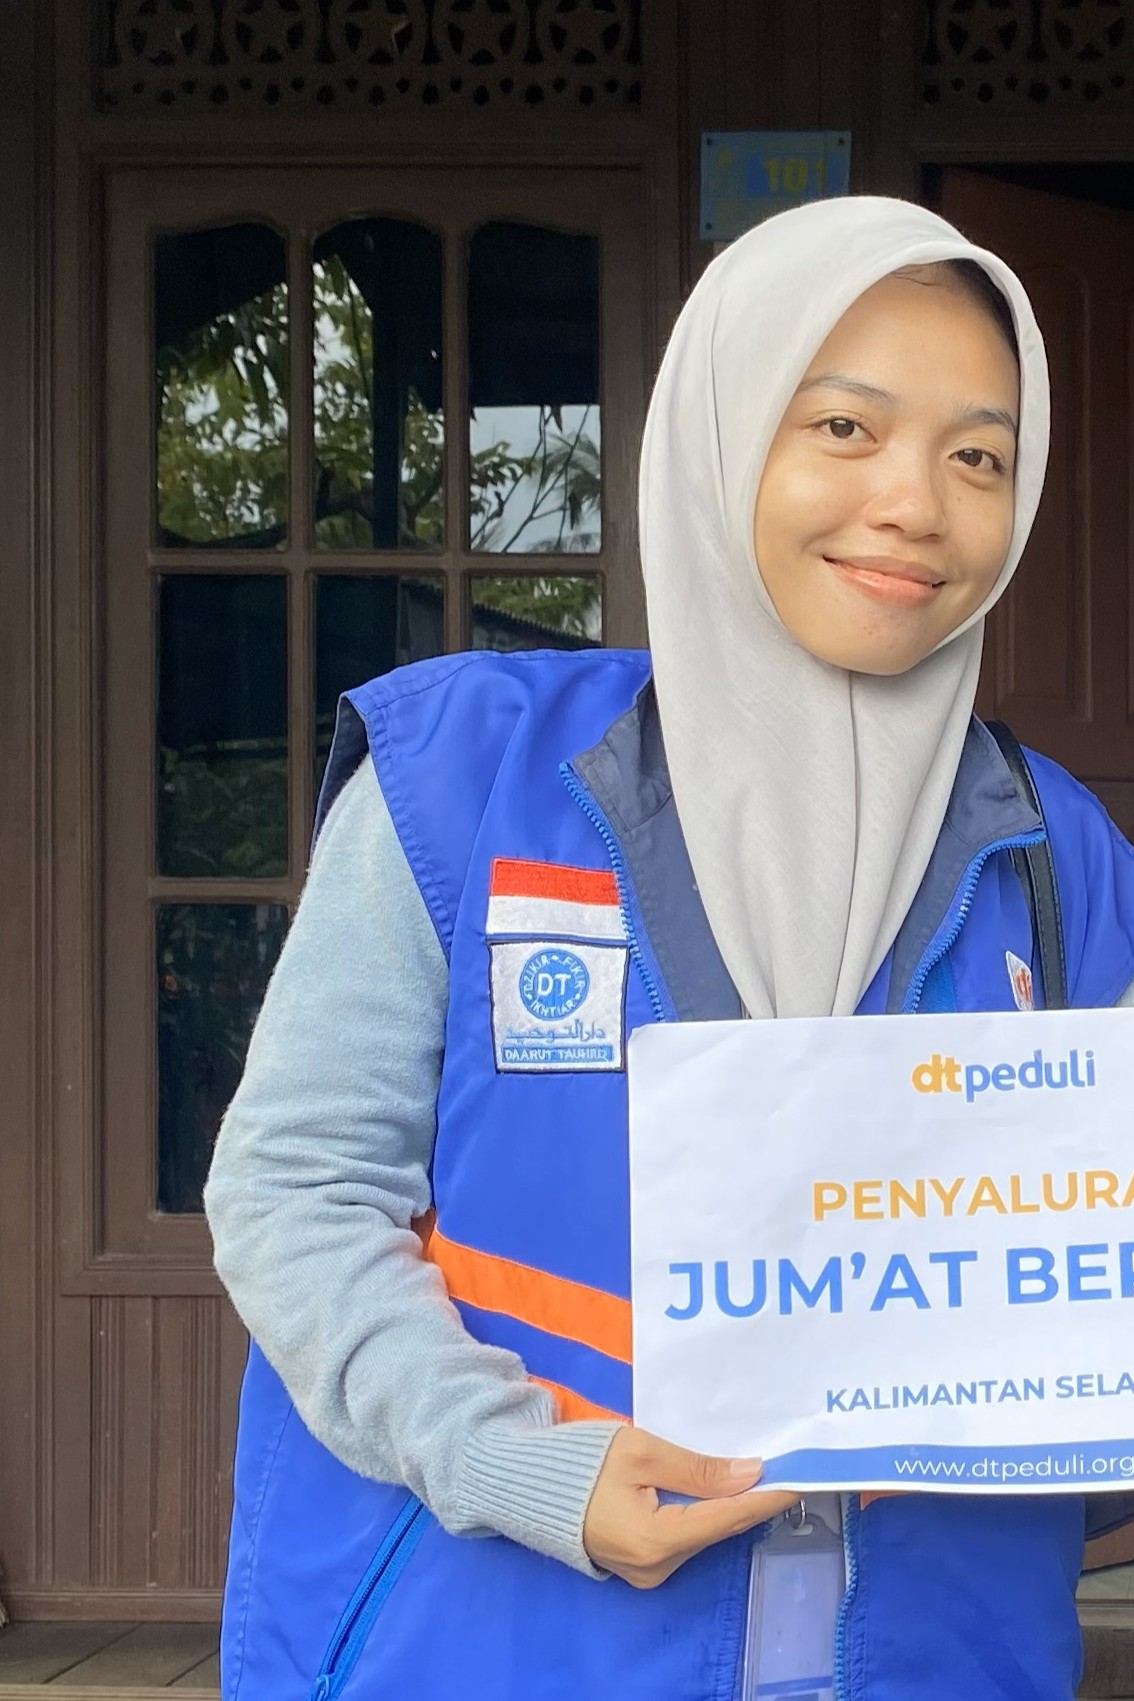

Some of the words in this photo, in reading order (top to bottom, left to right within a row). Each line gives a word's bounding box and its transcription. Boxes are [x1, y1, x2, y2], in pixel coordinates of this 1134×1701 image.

[764, 157, 826, 194] 101
[523, 954, 550, 993] DZIKIR
[537, 973, 571, 996] DT
[563, 955, 586, 992] FIKIR
[530, 999, 576, 1017] IKHTIAR
[505, 1047, 552, 1061] DAARUT
[911, 1050, 1096, 1102] dtpeduli
[826, 1377, 1045, 1412] KALIMANTAN
